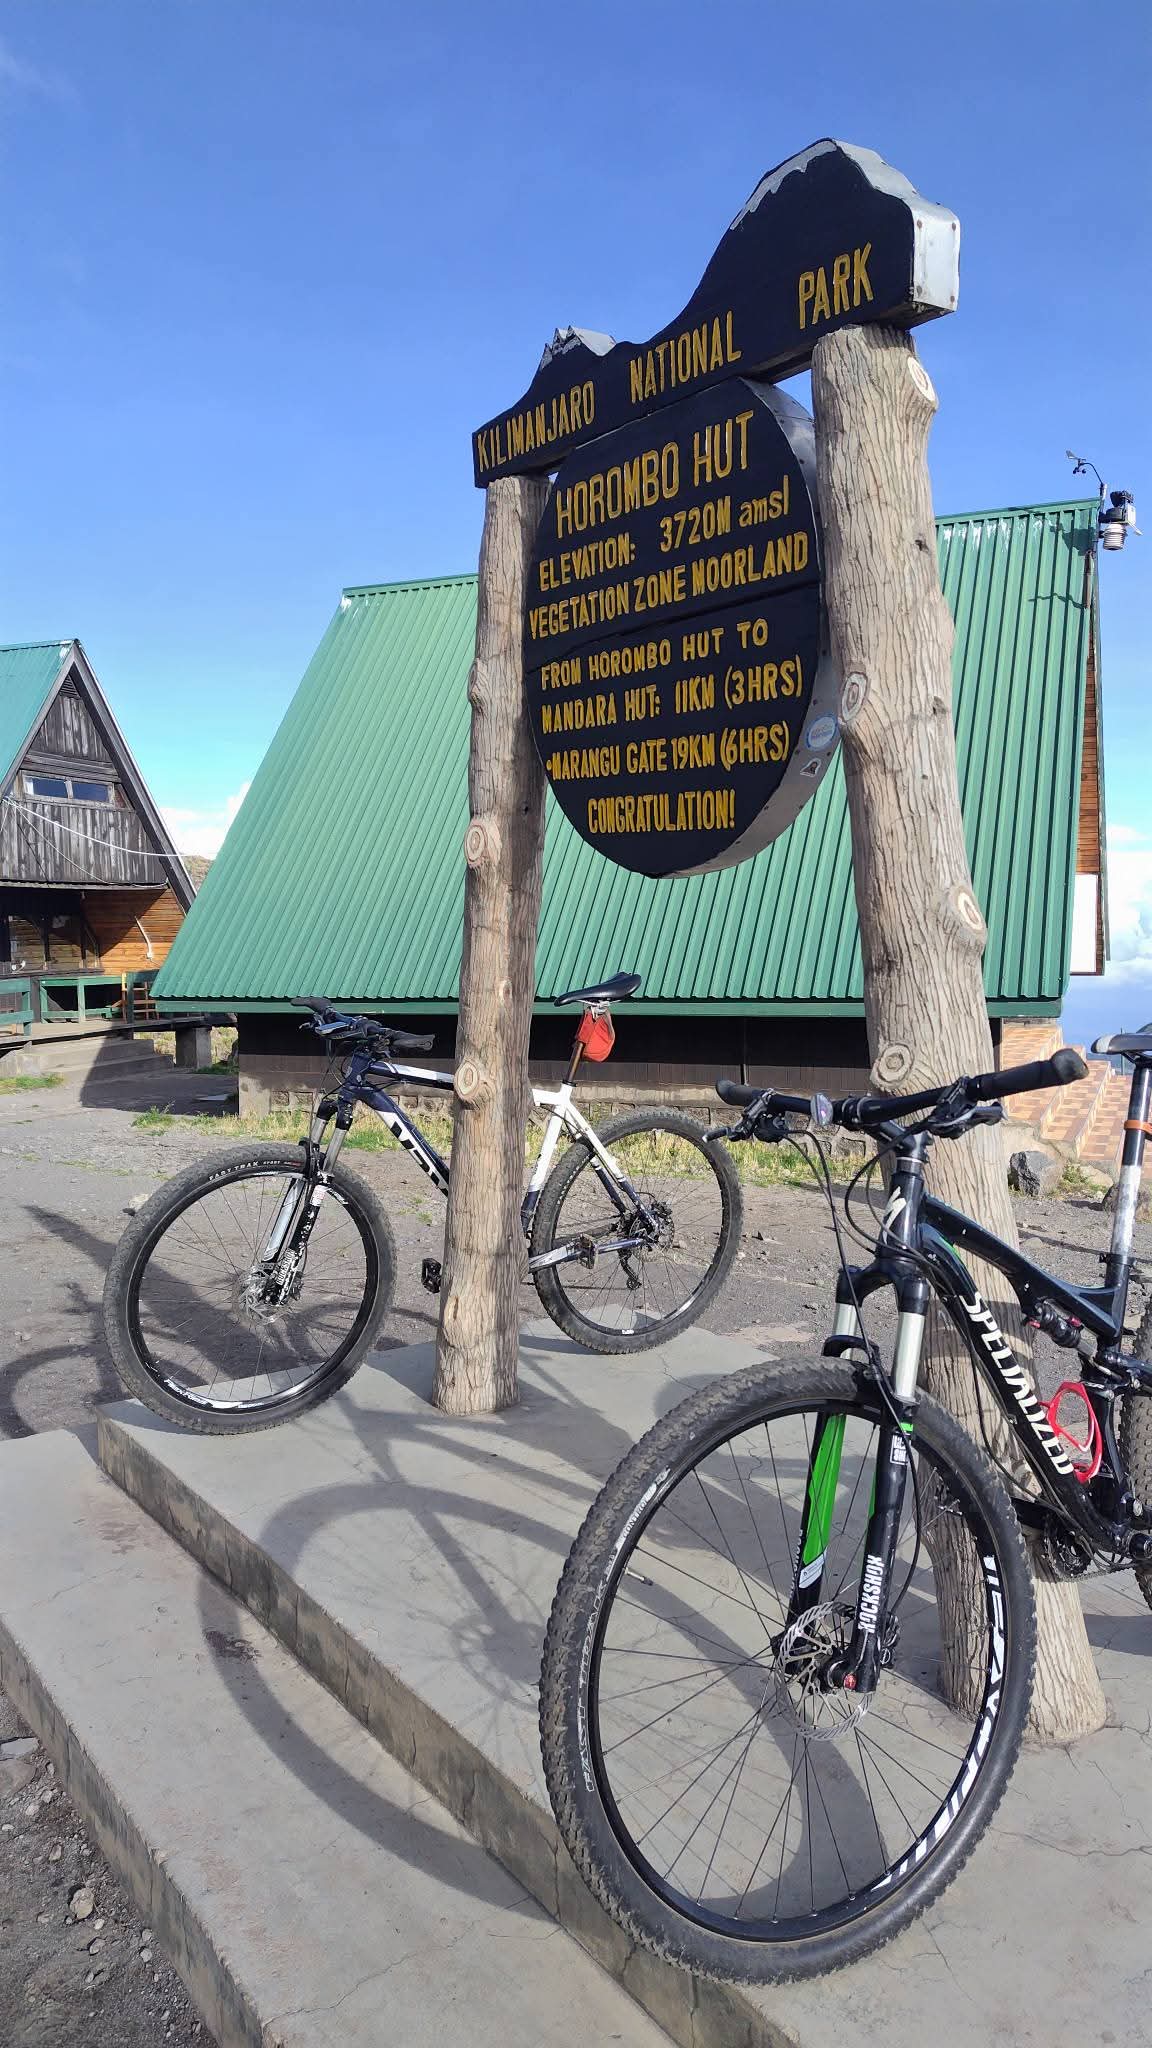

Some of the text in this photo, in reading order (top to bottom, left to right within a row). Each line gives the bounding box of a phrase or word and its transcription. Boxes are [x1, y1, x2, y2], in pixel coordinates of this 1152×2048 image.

[477, 241, 874, 469] KILIMANJARO NATIONAL PARK
[556, 410, 754, 539] HOROMBO HUT
[539, 475, 789, 592] ELEVATION: 3720M amsl
[529, 582, 630, 640] VEGETATION
[633, 564, 686, 613] ZONE
[541, 618, 768, 689] FROM HOROMBO HUT TO
[541, 655, 803, 734] MANDARA HUT: 11KM (3HRS)
[551, 745, 620, 781] MARANGU
[626, 738, 668, 774] GATE
[670, 732, 716, 770] 19KM
[719, 720, 790, 772] (6HRS)
[587, 789, 736, 834] CONGRATULATION!
[858, 1554, 885, 1634] ROCKSHOX
